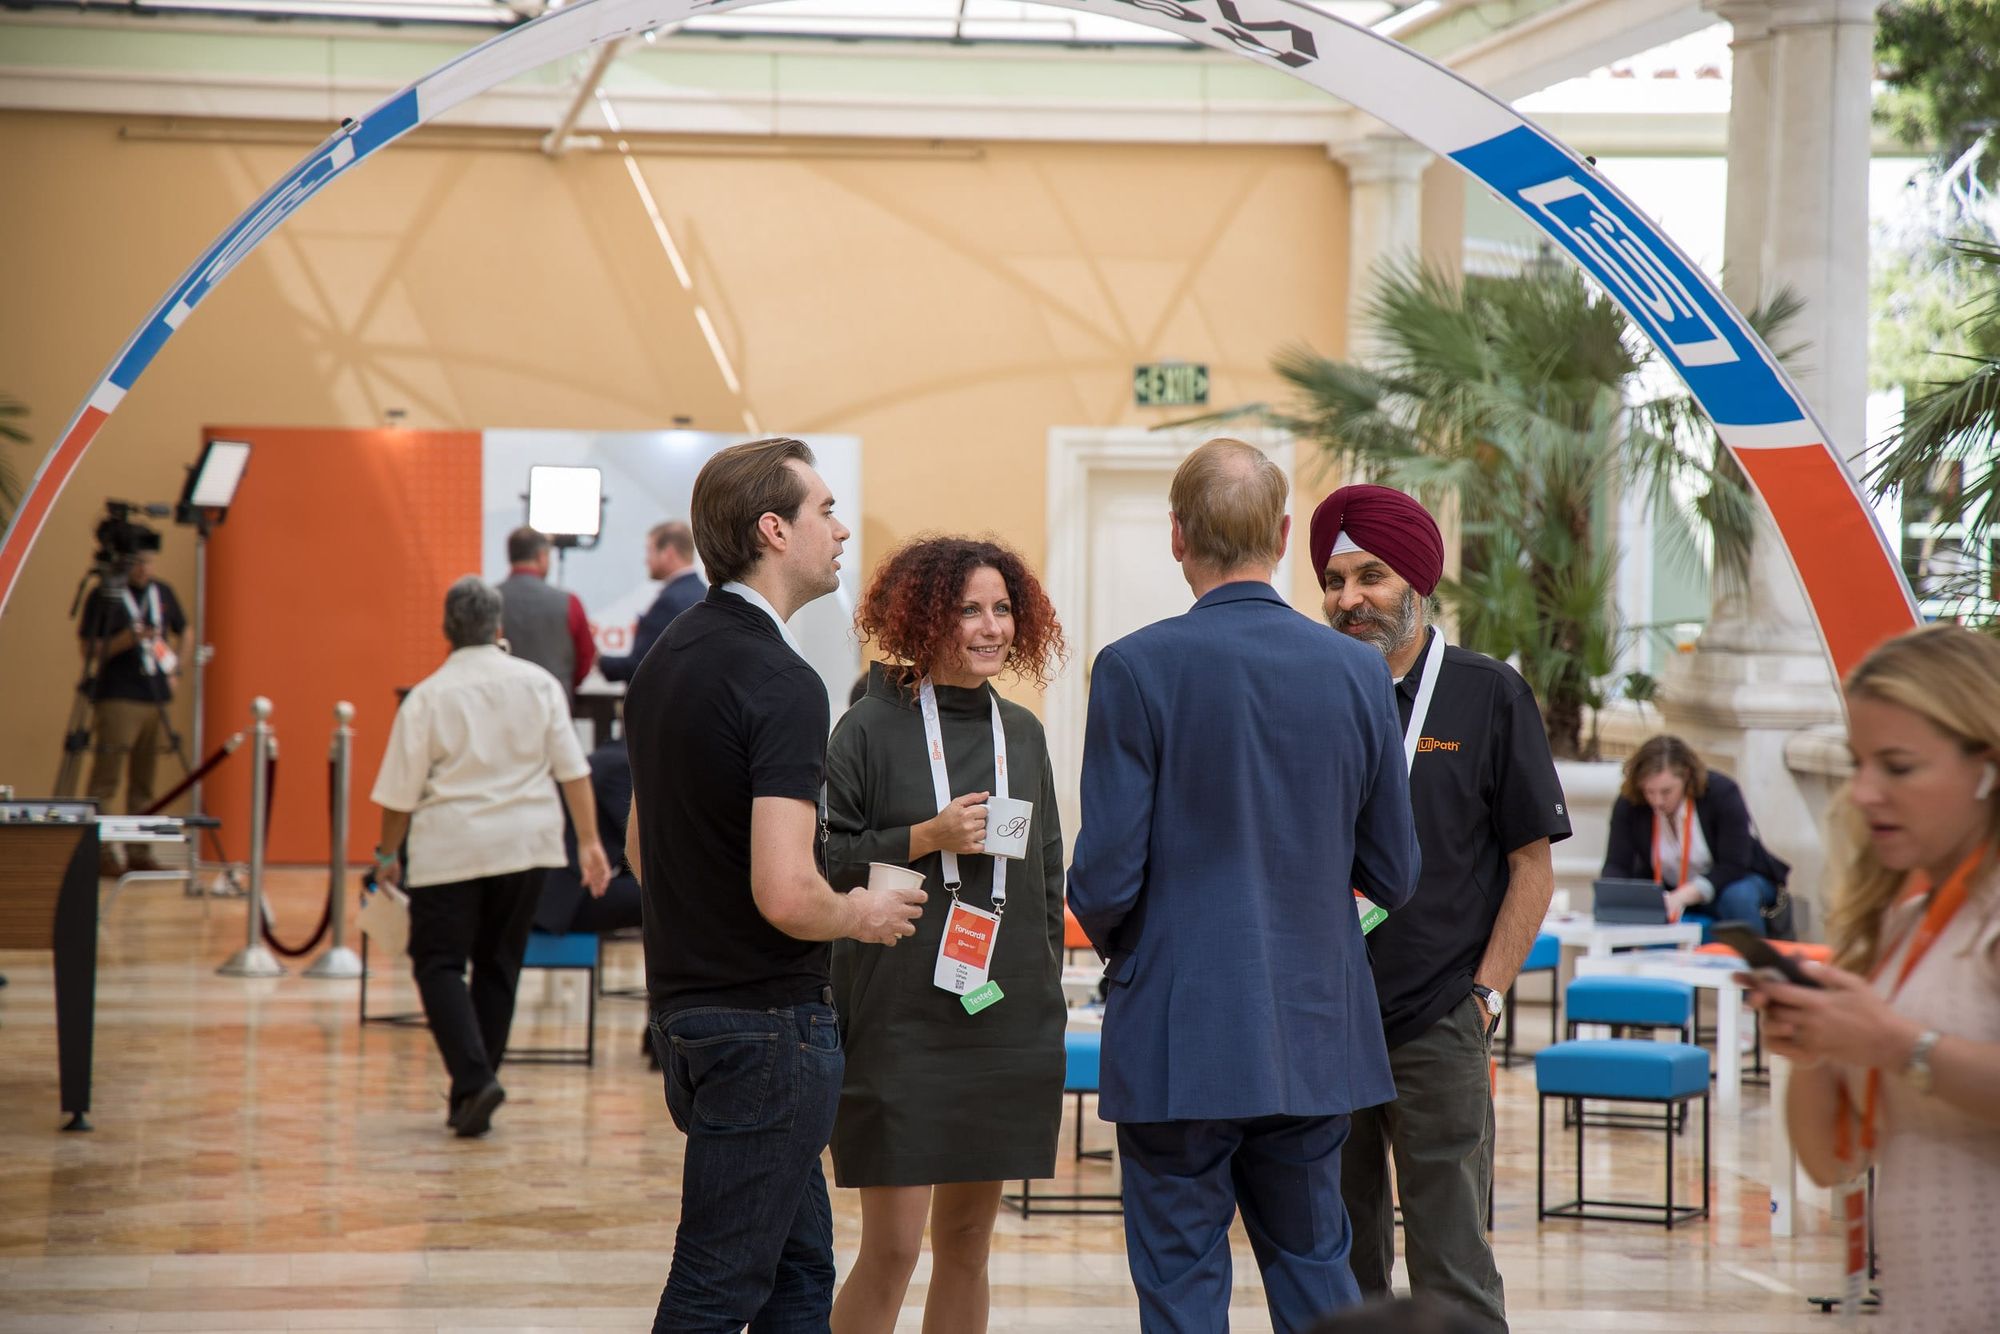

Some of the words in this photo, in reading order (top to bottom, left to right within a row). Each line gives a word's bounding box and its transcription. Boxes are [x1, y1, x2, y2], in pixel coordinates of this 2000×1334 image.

[1149, 367, 1195, 404] EXIT
[1418, 738, 1459, 752] UiPath
[997, 817, 1030, 839] B
[1361, 912, 1379, 929] sted
[968, 988, 993, 1006] Tested
